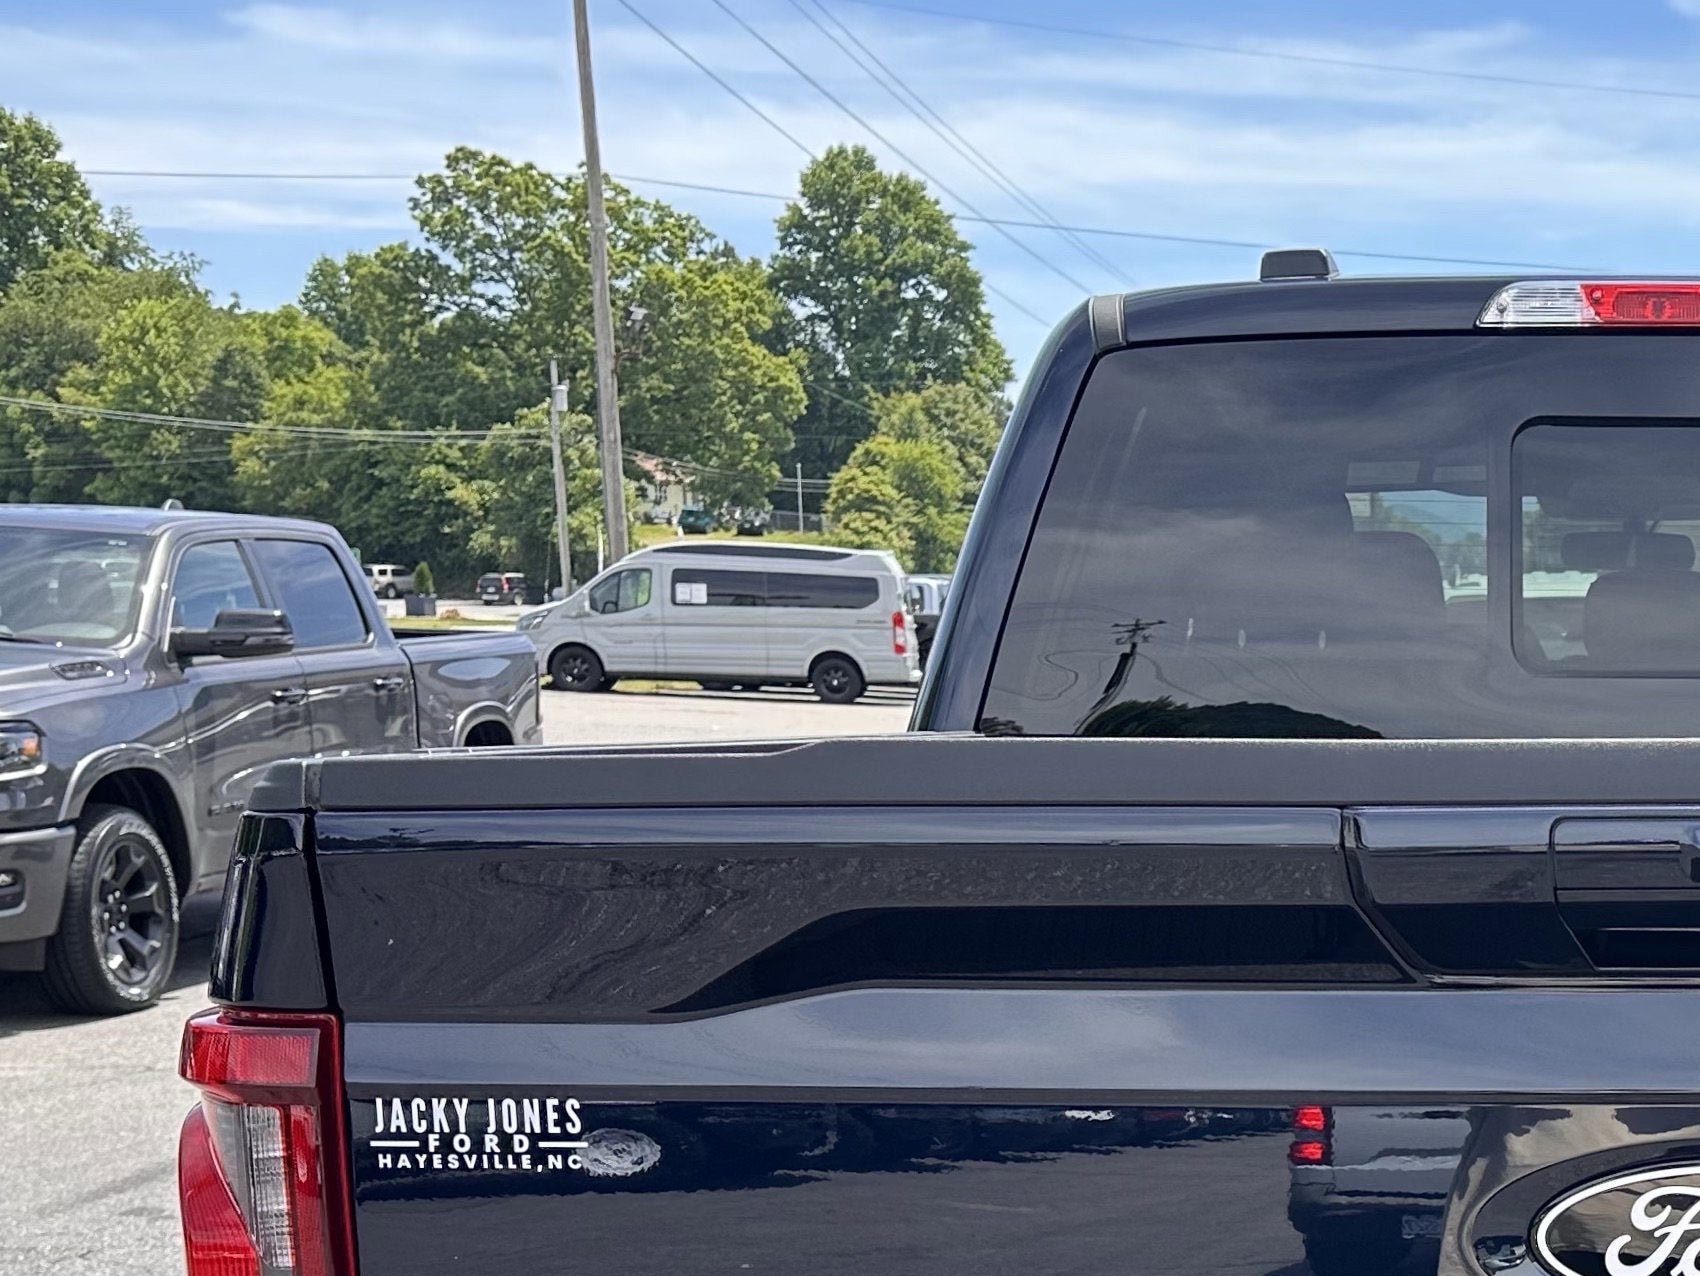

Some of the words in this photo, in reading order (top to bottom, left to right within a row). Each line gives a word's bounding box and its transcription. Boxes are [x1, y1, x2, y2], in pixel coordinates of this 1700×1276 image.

[375, 1097, 468, 1133] JACKY
[487, 1097, 582, 1134] JONES
[428, 1133, 530, 1153] FORD
